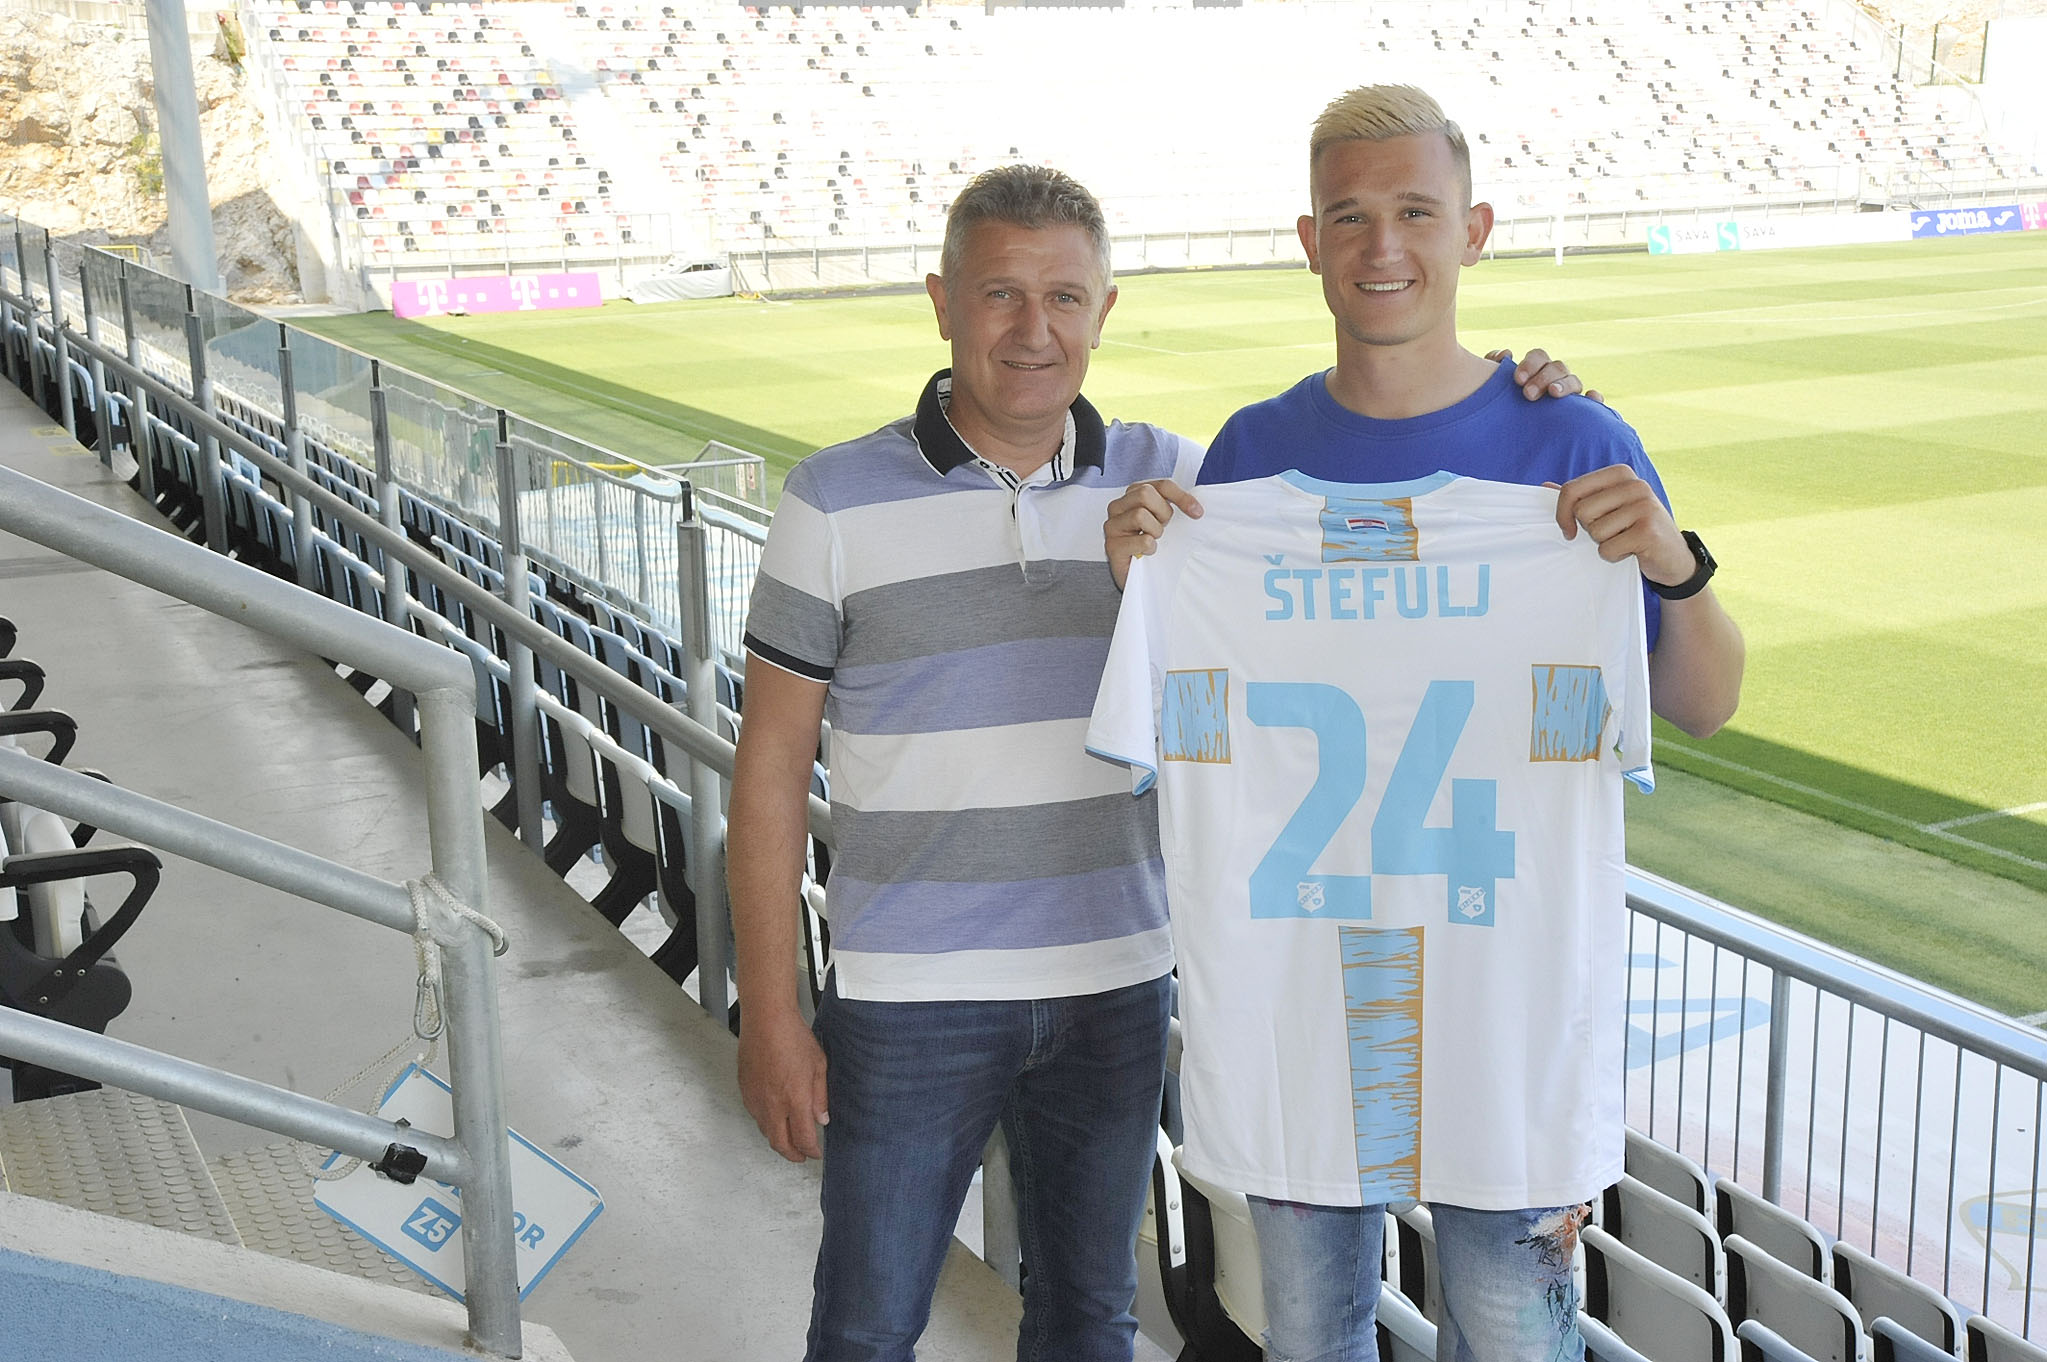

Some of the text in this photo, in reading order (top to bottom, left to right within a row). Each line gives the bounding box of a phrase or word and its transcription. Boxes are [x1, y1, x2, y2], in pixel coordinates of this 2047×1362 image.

[1675, 230, 1709, 242] SAVA
[1743, 226, 1776, 239] SAVA
[1263, 554, 1490, 621] ŠTEFULJ
[1246, 680, 1516, 927] 24
[409, 1206, 452, 1243] Z5
